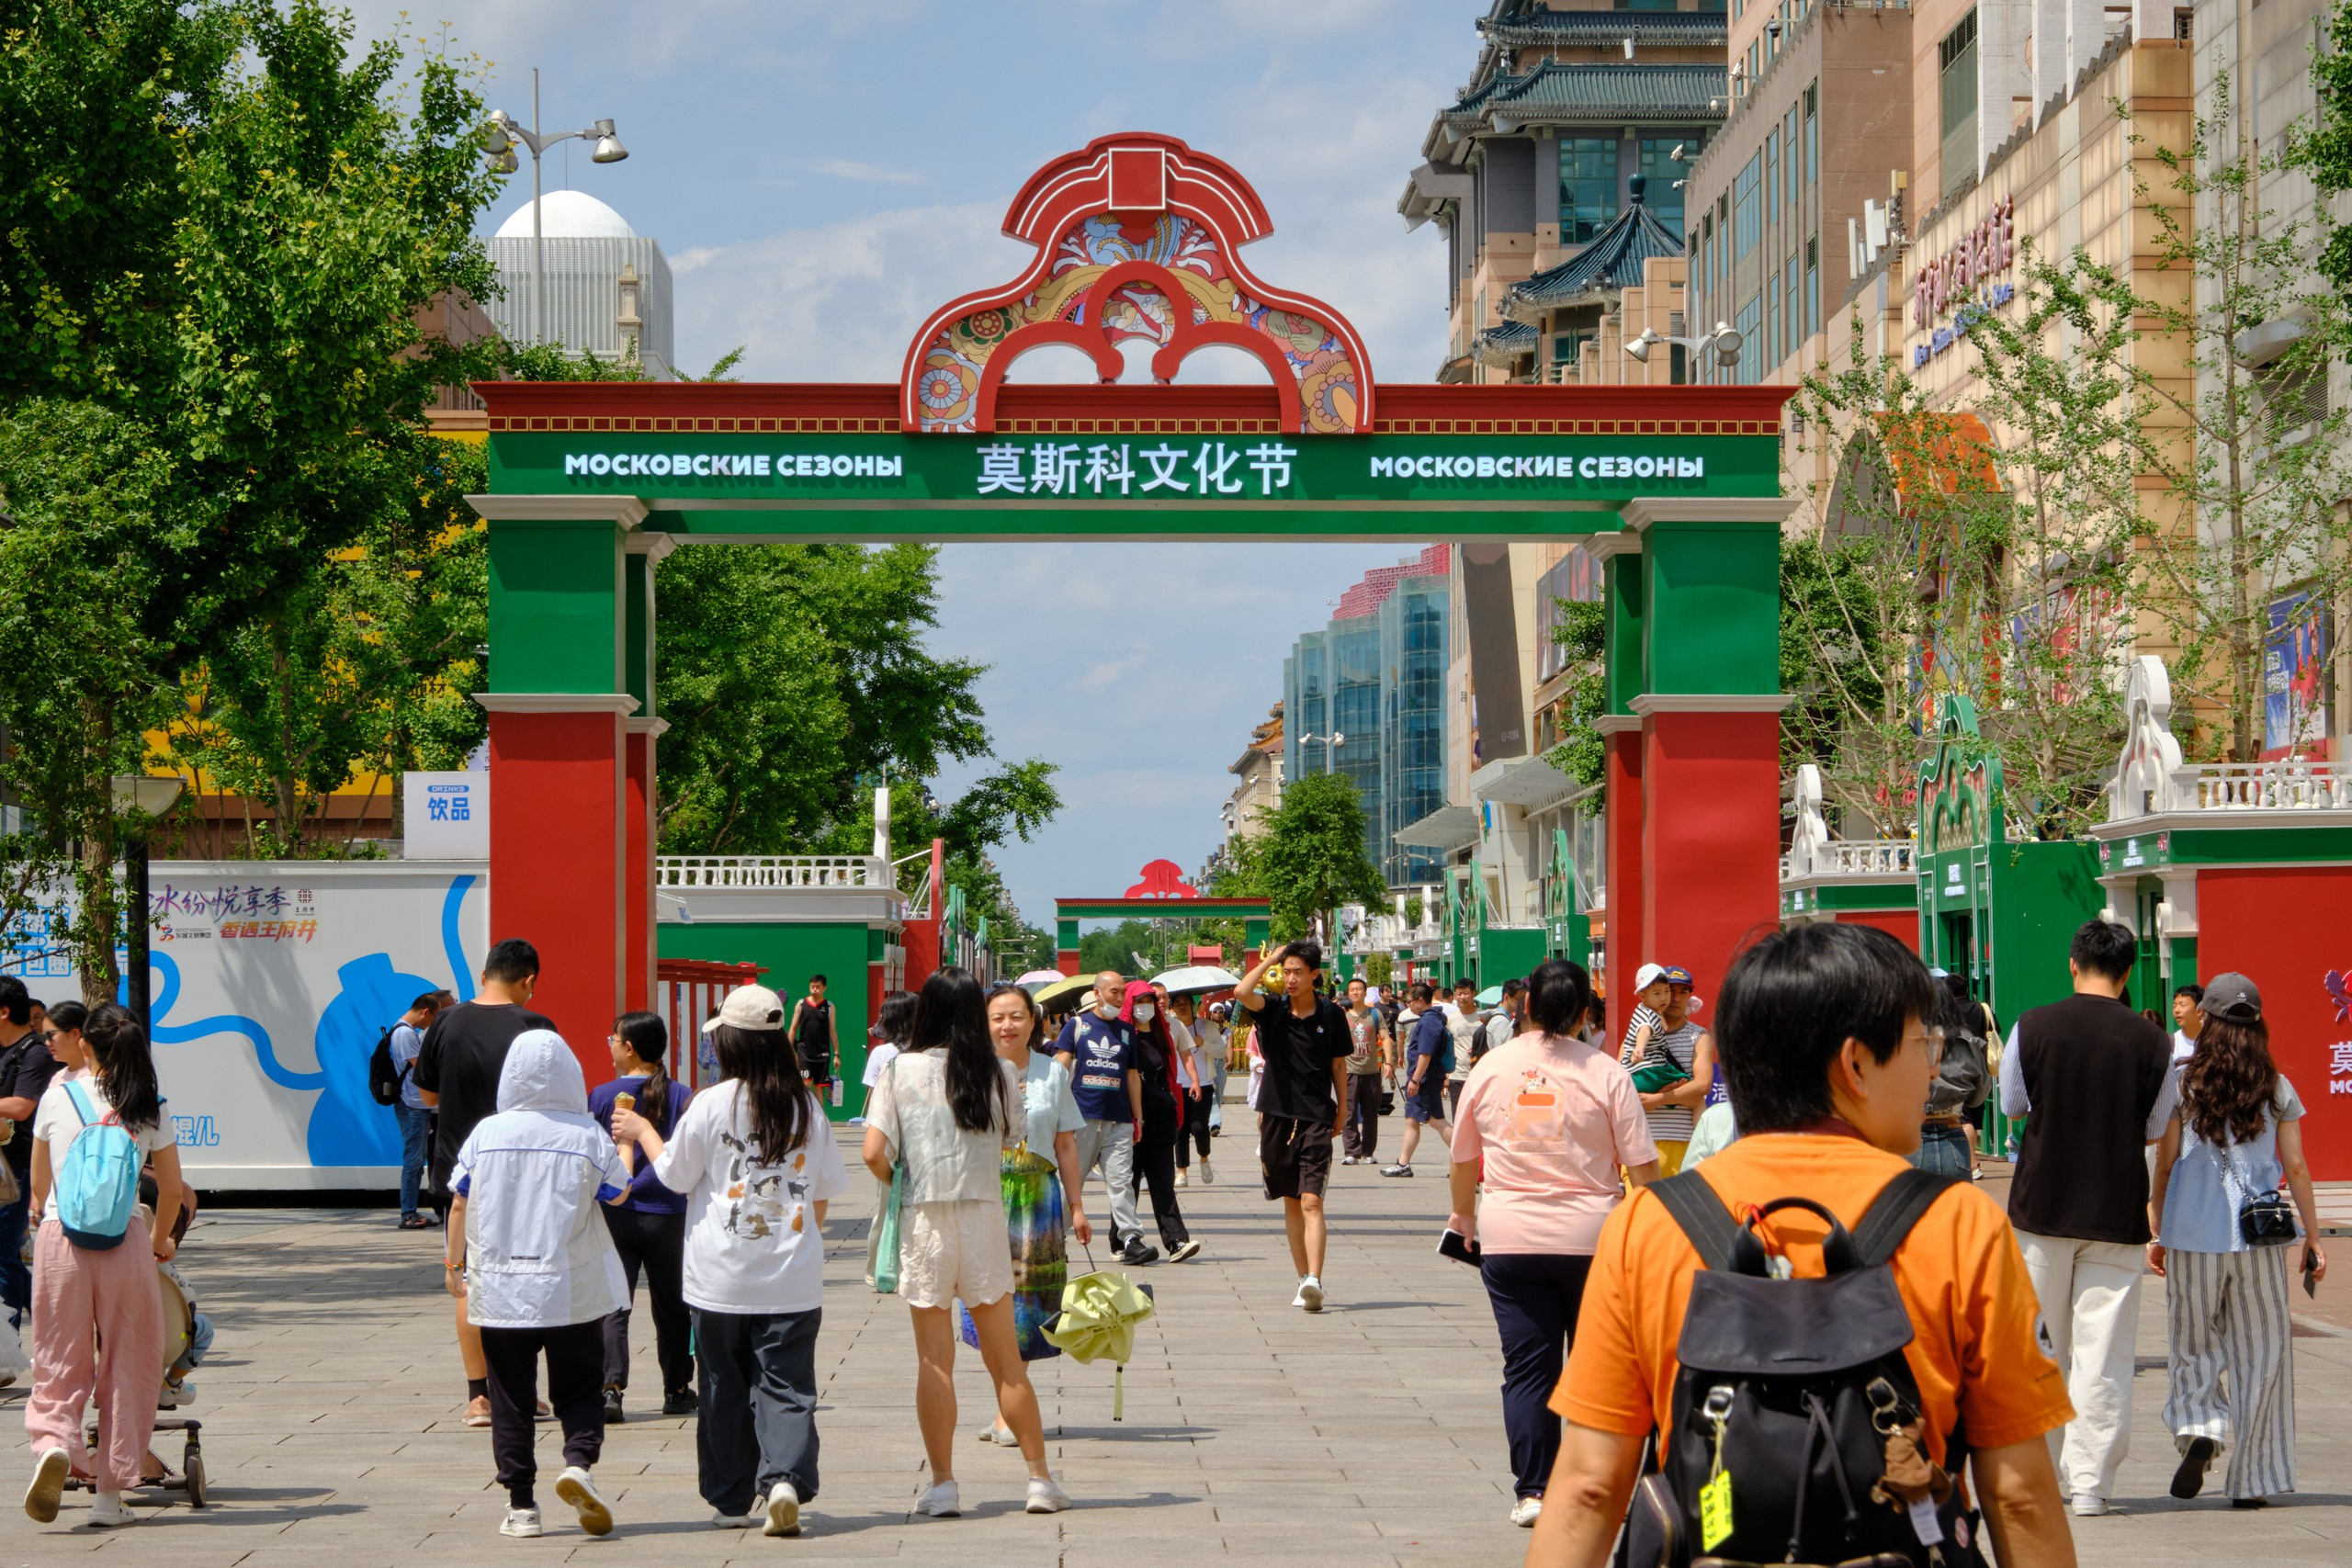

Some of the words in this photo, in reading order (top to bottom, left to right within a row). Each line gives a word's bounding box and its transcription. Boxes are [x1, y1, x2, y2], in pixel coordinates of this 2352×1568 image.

[565, 454, 770, 476] МОСКОВСКИЕ
[776, 455, 902, 477] СЕЗОНЫ
[977, 443, 1297, 495] 莫斯科文化节
[1371, 456, 1573, 478] МОСКОВСКИЕ
[1578, 457, 1703, 479] СЕЗОНЫ
[428, 796, 470, 821] 饮品
[220, 919, 319, 944] 香遇王府井
[1086, 1057, 1120, 1070] adidas
